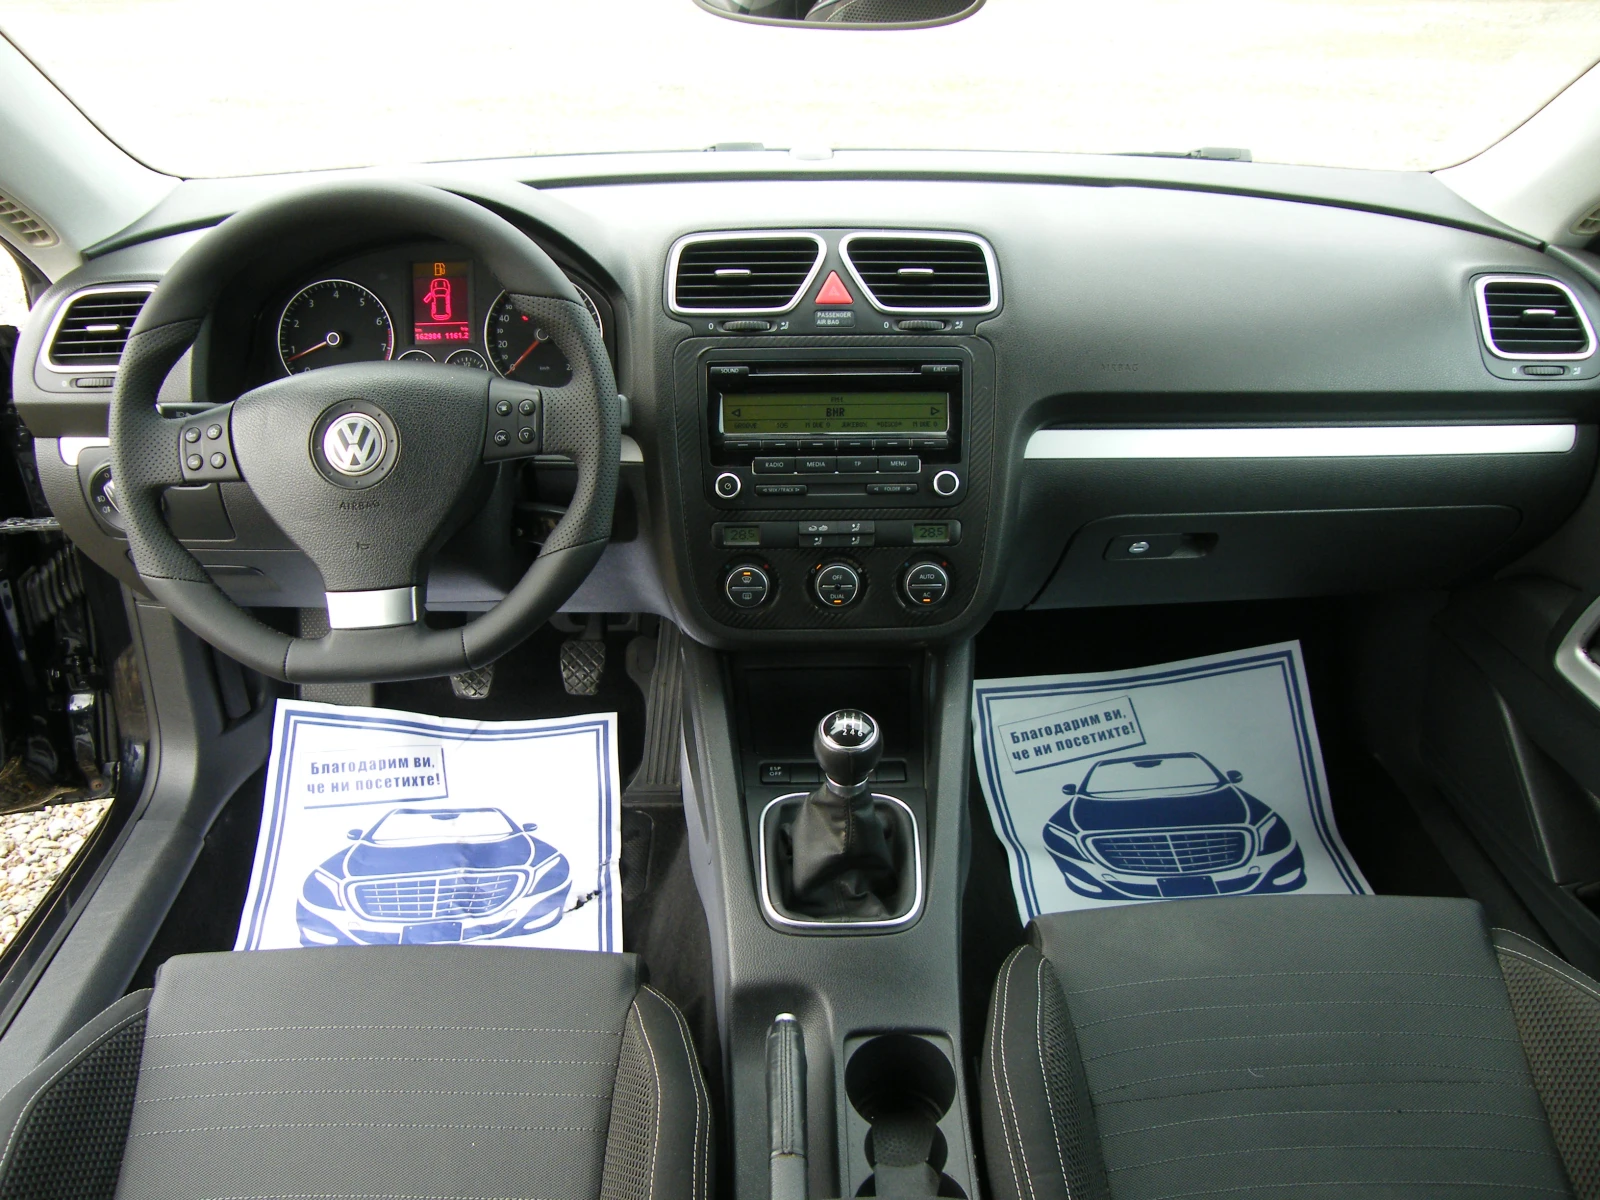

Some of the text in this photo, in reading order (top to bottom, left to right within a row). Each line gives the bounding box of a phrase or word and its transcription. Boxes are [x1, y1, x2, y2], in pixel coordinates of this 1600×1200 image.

[333, 290, 340, 299] 4
[308, 299, 314, 308] 3
[360, 298, 365, 307] 5
[376, 317, 383, 326] 6
[499, 314, 510, 322] 40
[294, 320, 300, 328] 2
[381, 343, 387, 352] 7
[498, 340, 508, 348] 20
[291, 345, 296, 354] 1
[1100, 363, 1139, 372] AIRBAG
[338, 499, 381, 511] AIRBAG
[919, 526, 944, 538] 28.5
[1010, 708, 1127, 744] Благодарим ви,
[1012, 721, 1136, 761] че ни посетихте!
[311, 756, 435, 775] Благодарим ви,
[307, 773, 441, 794] че ни посетихте!
